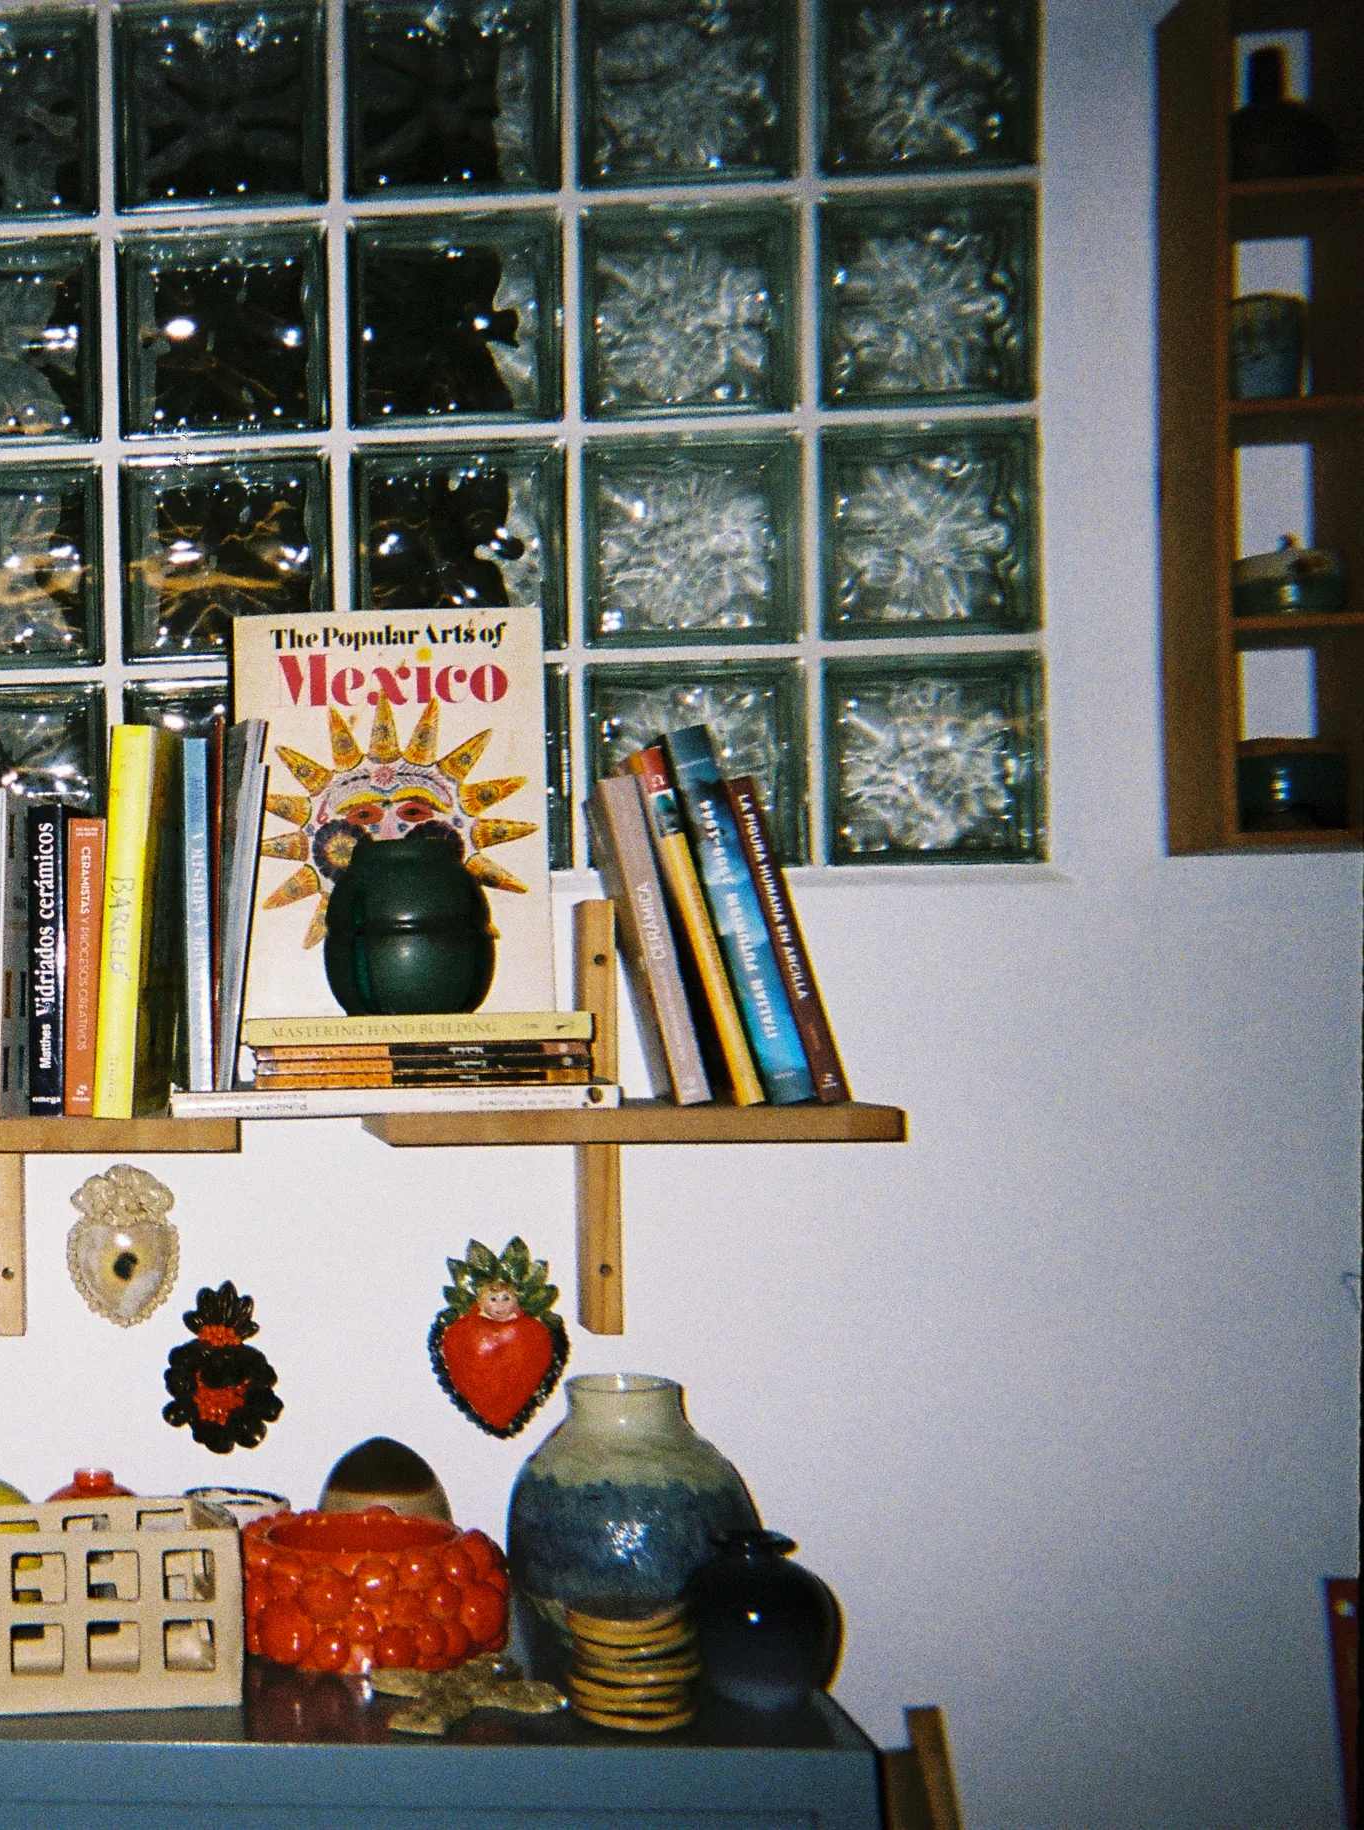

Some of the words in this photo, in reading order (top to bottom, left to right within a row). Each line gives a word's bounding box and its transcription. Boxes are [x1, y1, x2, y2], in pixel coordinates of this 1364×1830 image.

[271, 628, 318, 649] The
[322, 625, 419, 651] Popular
[425, 623, 475, 645] Arts
[479, 621, 507, 648] of
[277, 650, 508, 707] Mexico
[738, 794, 752, 811] LA
[743, 812, 766, 862] FIGURA
[33, 822, 55, 919] cerámicos
[81, 846, 91, 914] CERAMISTAS
[758, 863, 785, 922] HUMANA
[725, 893, 759, 972] FUTURISM
[775, 923, 792, 945] EN
[35, 926, 56, 1017] Vidriados
[782, 945, 808, 1000] ARCILLA
[269, 1024, 363, 1039] MASTERING
[367, 1022, 415, 1036] HAND
[750, 978, 779, 1039] ITALIAN
[39, 1024, 52, 1069] Matthes
